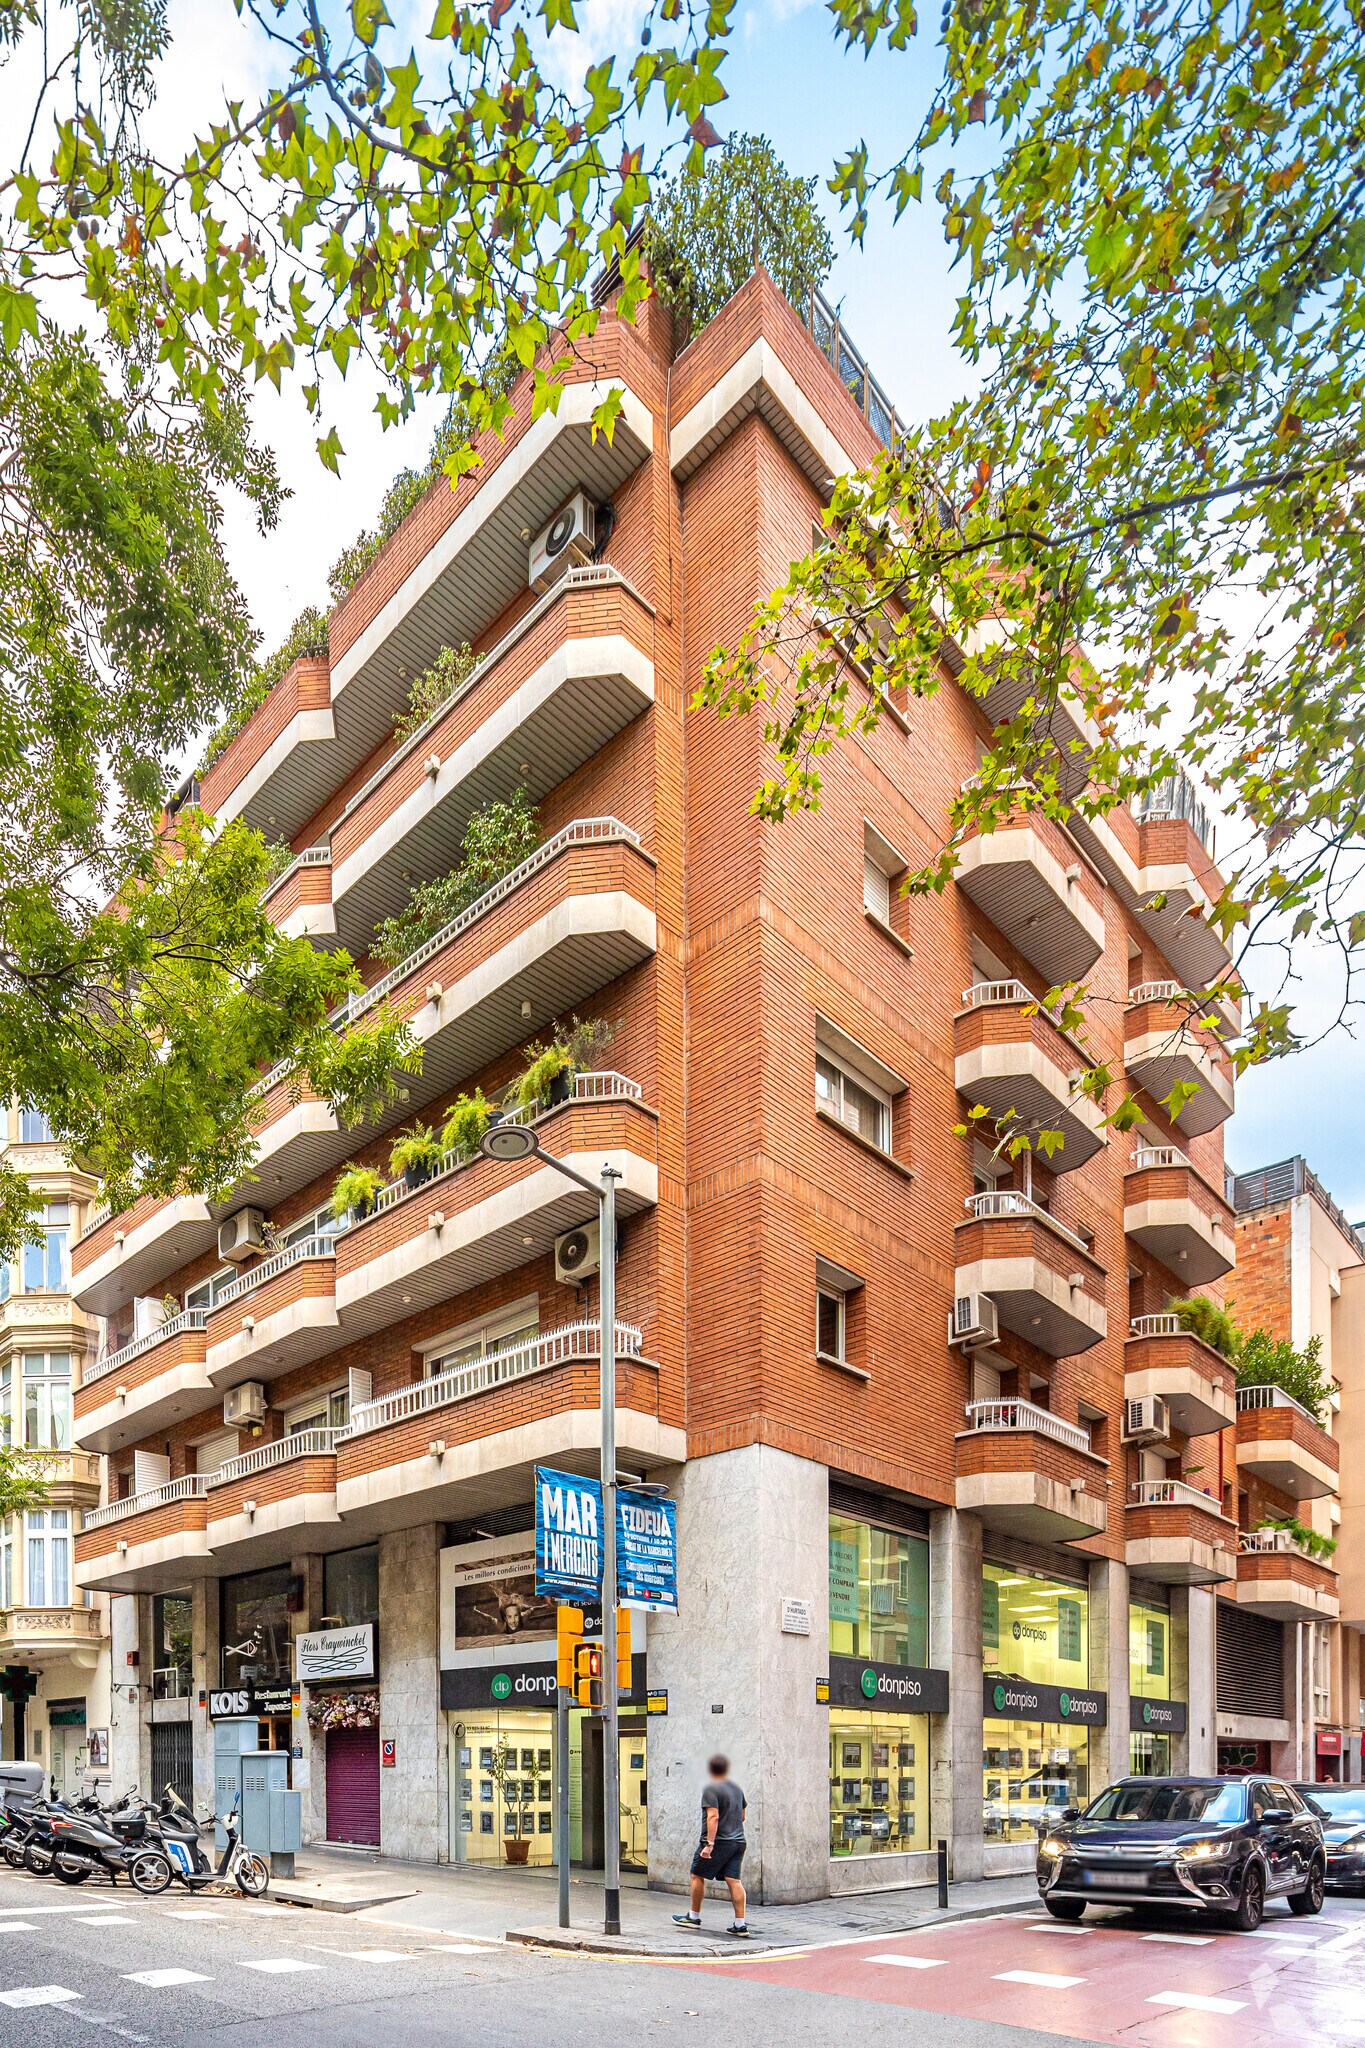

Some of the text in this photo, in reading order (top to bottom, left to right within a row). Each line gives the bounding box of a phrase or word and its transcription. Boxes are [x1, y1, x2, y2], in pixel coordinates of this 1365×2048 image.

[541, 1483, 598, 1537] MAR
[620, 1504, 672, 1537] FIDEUÀ
[550, 1532, 598, 1578] MERCATS
[464, 1573, 474, 1581] Les
[475, 1569, 496, 1580] millors
[497, 1563, 531, 1576] condicions
[832, 1578, 855, 1588] COMPRAR
[832, 1592, 851, 1601] VENDRE
[301, 1631, 366, 1655] Flors Craywinckel
[1022, 1624, 1047, 1642] donpiso
[515, 1673, 557, 1696] donp
[877, 1673, 922, 1700] donpiso
[210, 1690, 249, 1715] KOIS
[254, 1688, 292, 1701] Restaurant
[1005, 1689, 1038, 1712] donpiso
[1069, 1696, 1098, 1717] donpiso
[1150, 1705, 1172, 1724] donpiso
